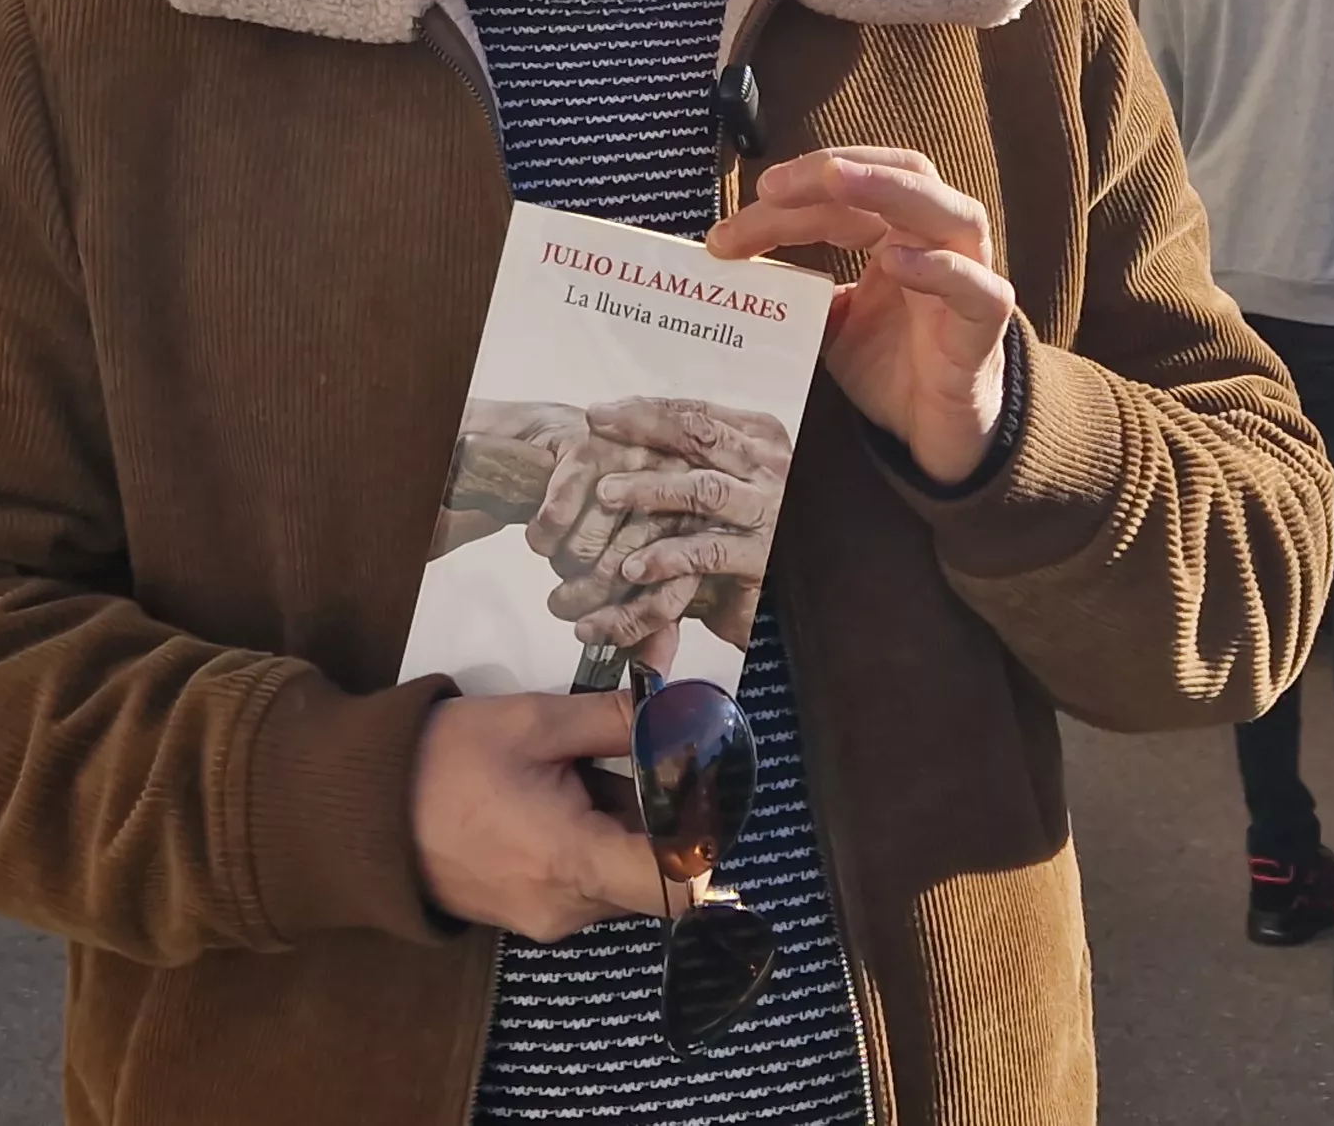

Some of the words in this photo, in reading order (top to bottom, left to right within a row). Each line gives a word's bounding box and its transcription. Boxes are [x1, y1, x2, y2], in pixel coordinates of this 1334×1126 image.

[541, 242, 613, 276] JULIO
[617, 261, 788, 322] LLAMAZARES
[564, 284, 588, 308] La
[595, 291, 652, 325] lluvia
[658, 313, 744, 349] amarilla
